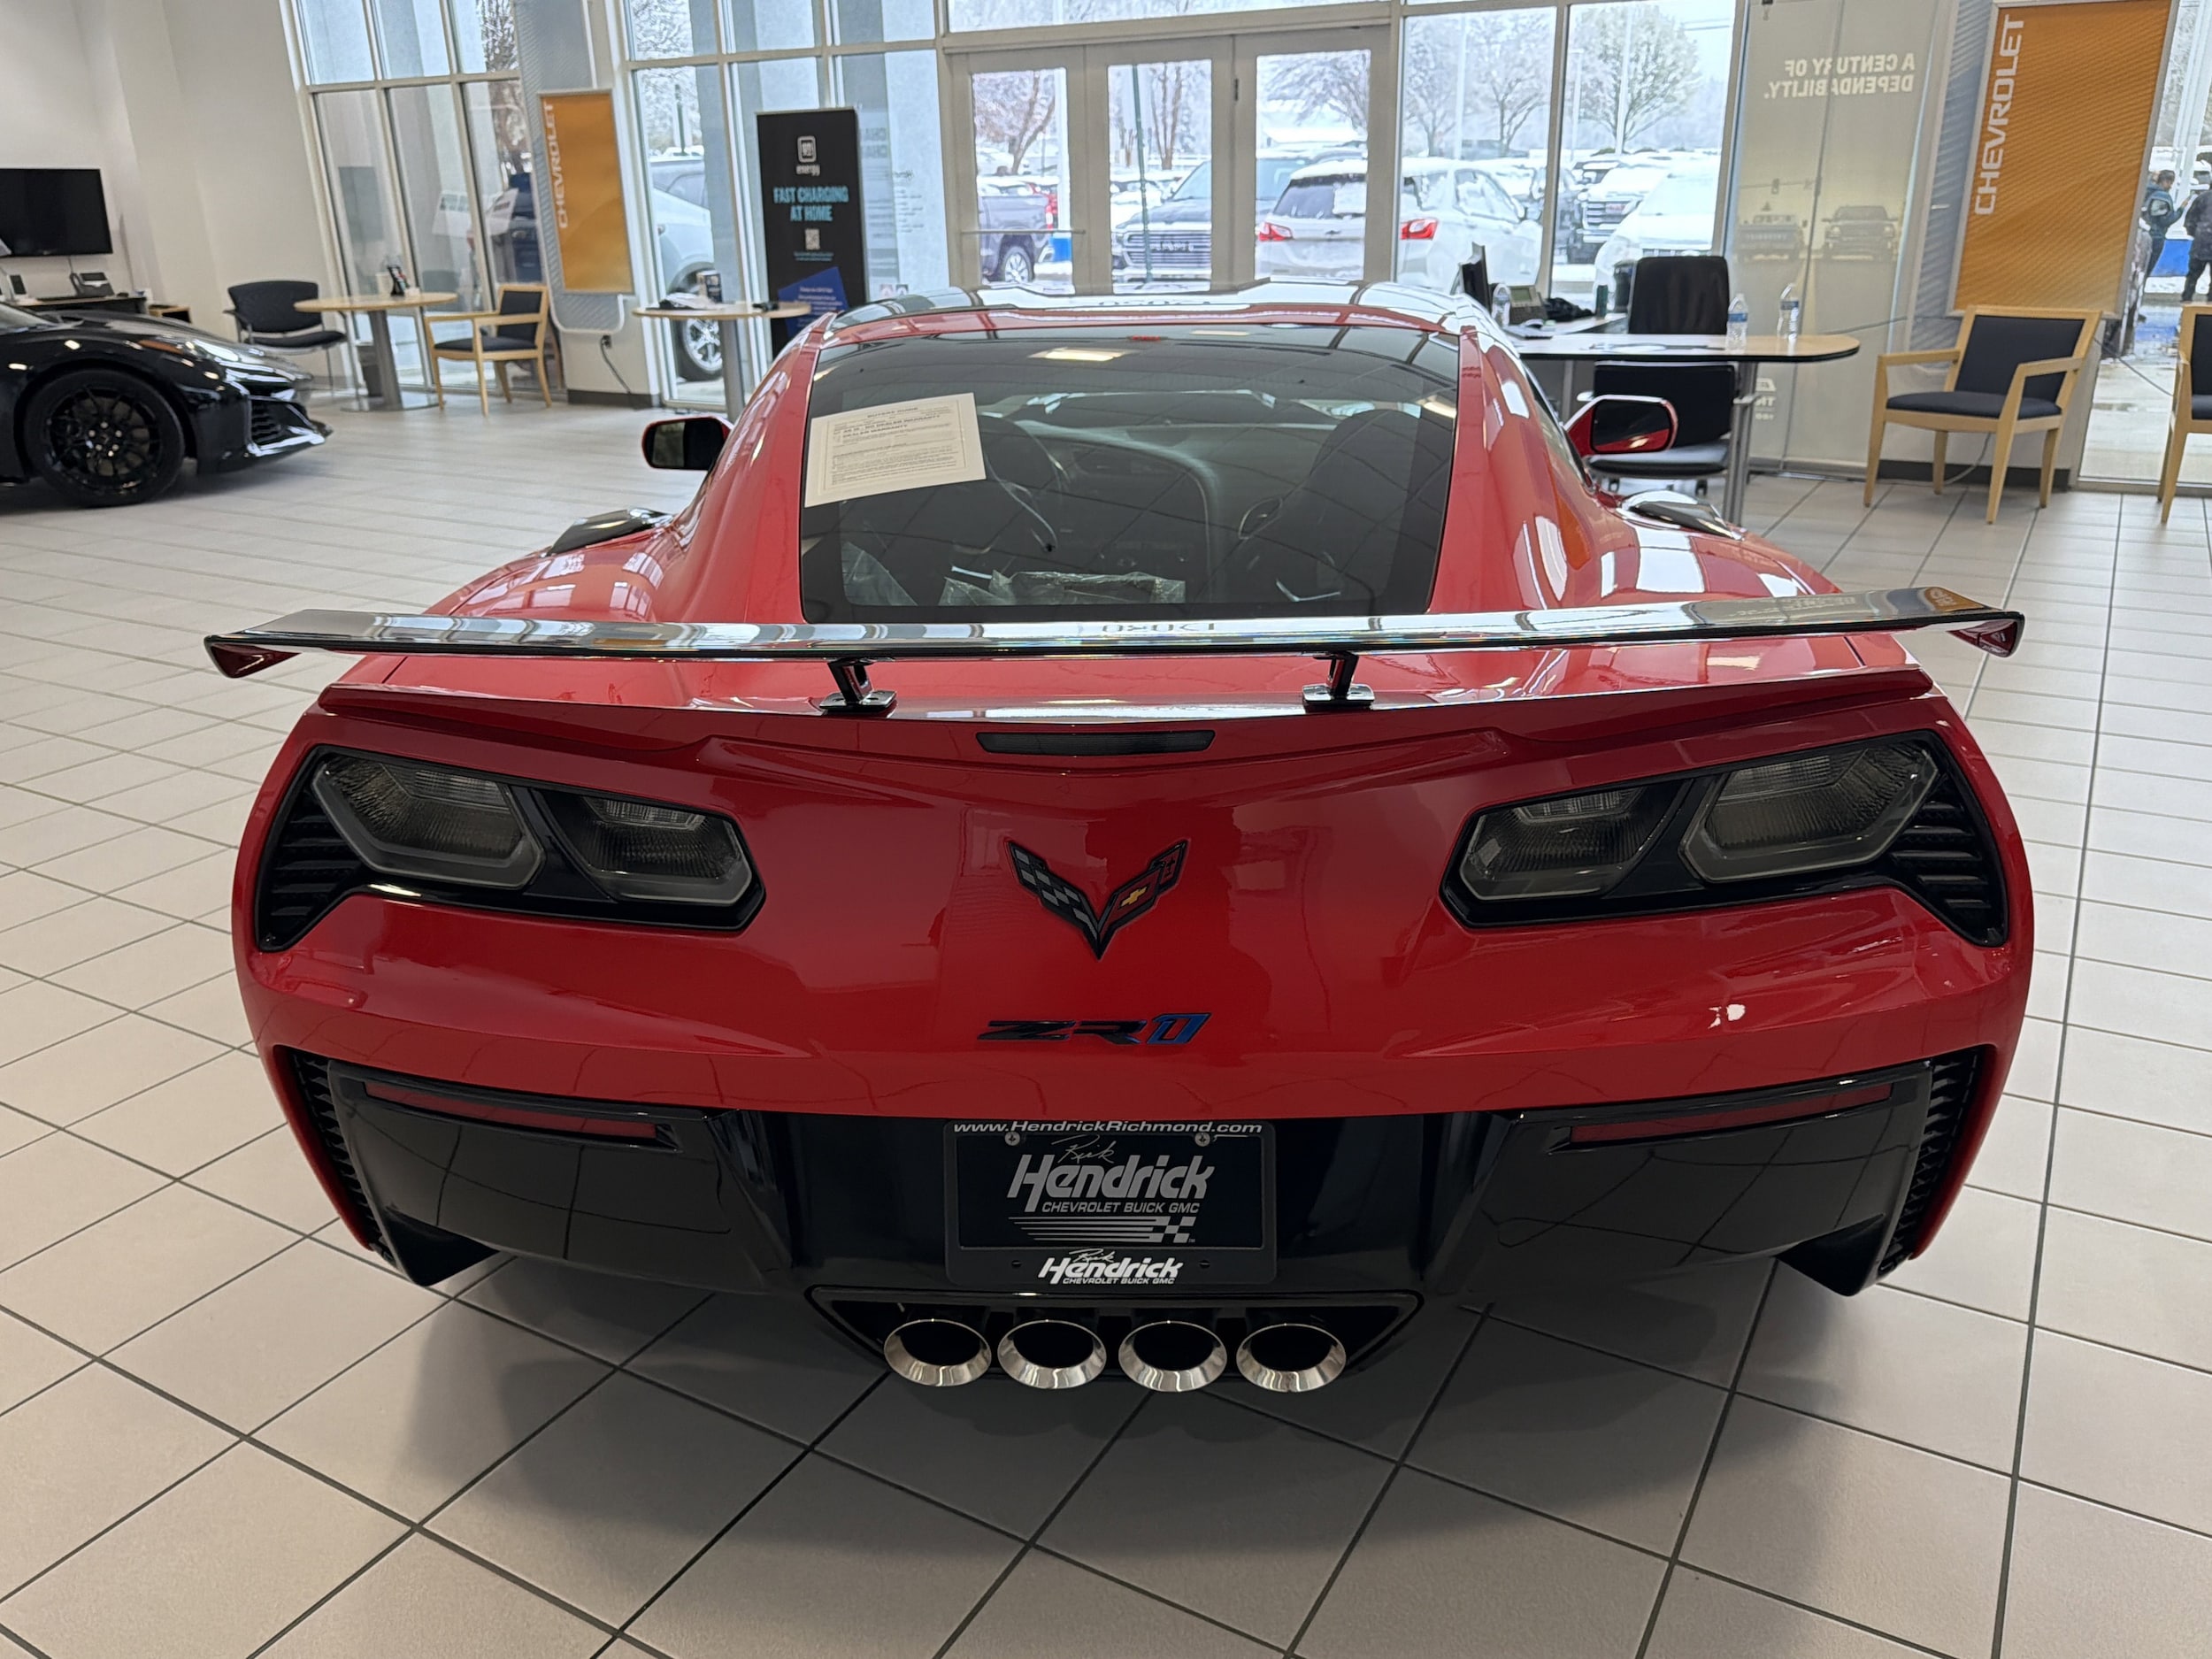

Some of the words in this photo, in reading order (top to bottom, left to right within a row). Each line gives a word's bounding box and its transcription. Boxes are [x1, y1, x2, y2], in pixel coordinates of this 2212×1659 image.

[1974, 14, 2024, 215] CHEVROLET
[543, 100, 568, 228] CHEVROLET
[795, 165, 821, 177] energy
[773, 187, 796, 204] FAST
[797, 186, 849, 204] CHARGING
[790, 204, 803, 222] AT
[803, 204, 833, 222] HOME
[976, 1012, 1212, 1046] ZR1
[953, 1120, 1263, 1133] www.HendrickRichmond.com
[1006, 1154, 1216, 1213] Hendrick
[1041, 1202, 1121, 1213] CHEVROLET
[1123, 1202, 1166, 1213] BUICK
[1168, 1202, 1201, 1214] GMC
[1037, 1257, 1184, 1285] Hendrick
